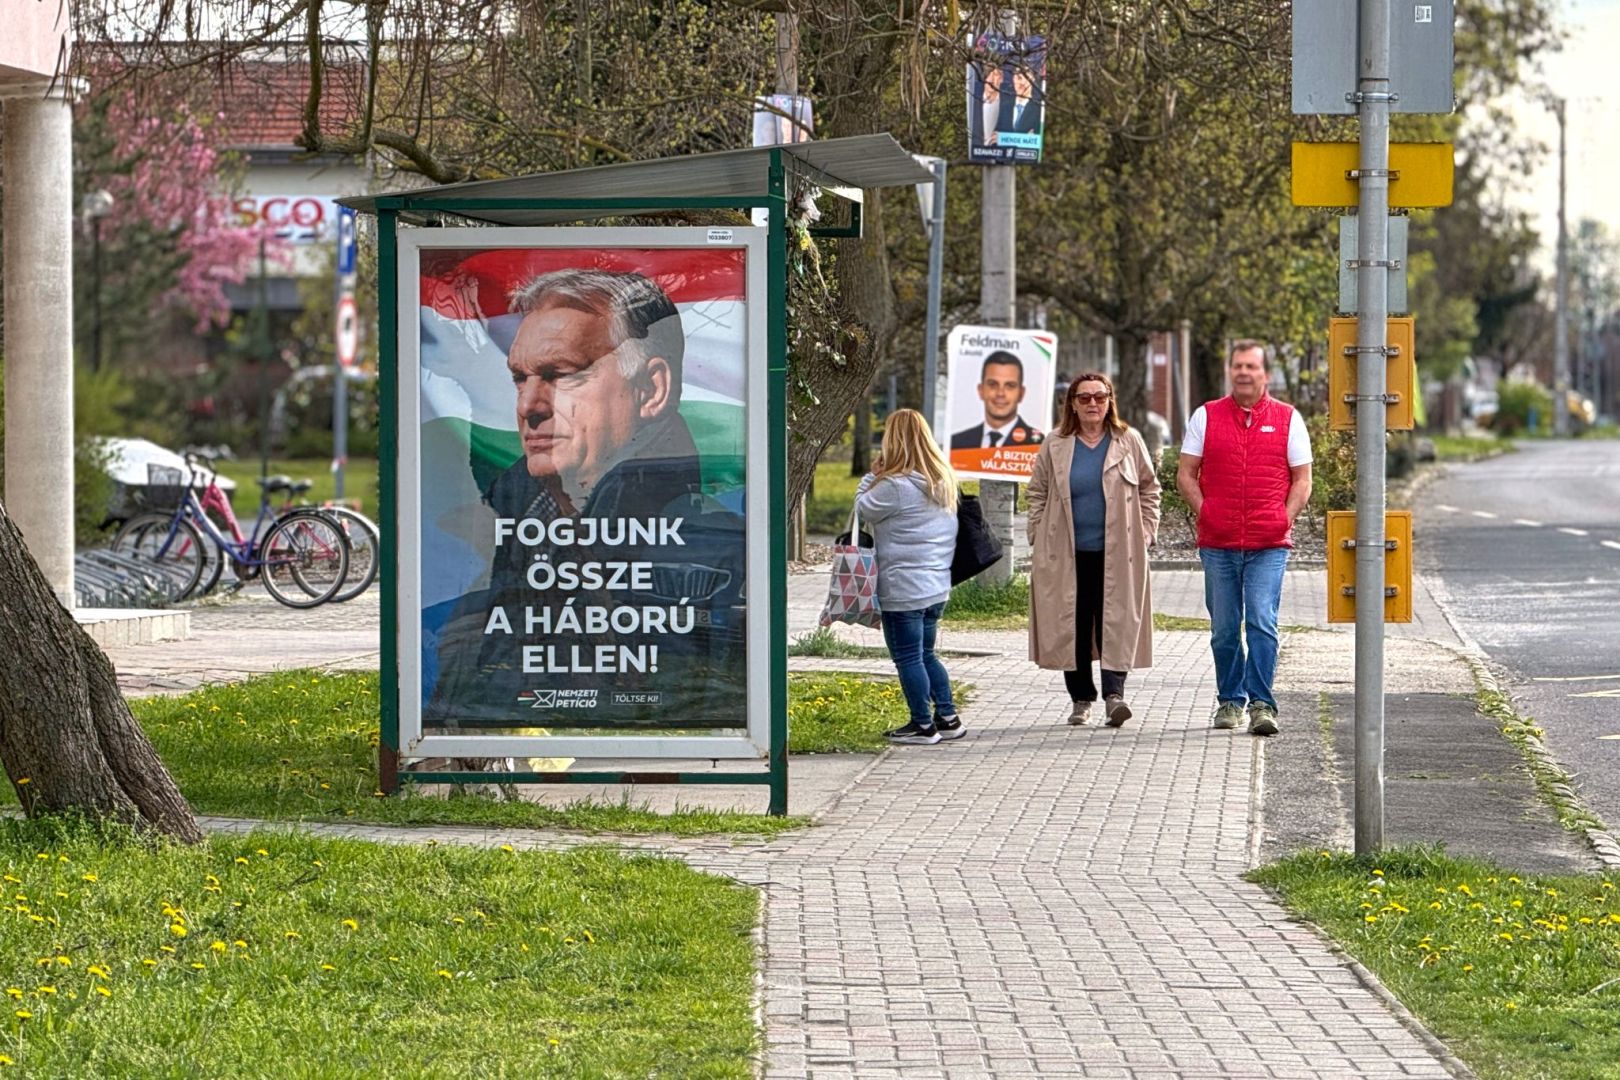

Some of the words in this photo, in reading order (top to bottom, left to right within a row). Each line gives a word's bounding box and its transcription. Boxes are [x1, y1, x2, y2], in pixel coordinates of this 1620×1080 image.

[960, 333, 1020, 350] Feldman
[993, 449, 1002, 460] A
[980, 458, 1034, 473] VÁLASZTÁ
[494, 517, 686, 546] FOGJUNK
[526, 553, 653, 590] ÖSSZE
[484, 606, 514, 635] A
[525, 597, 696, 635] HÁBORÚ
[522, 645, 659, 674] ELLEN!
[557, 689, 598, 697] NEMZETI
[615, 694, 645, 702] TÖLTSE
[556, 698, 597, 708] PETÍCIÓ
